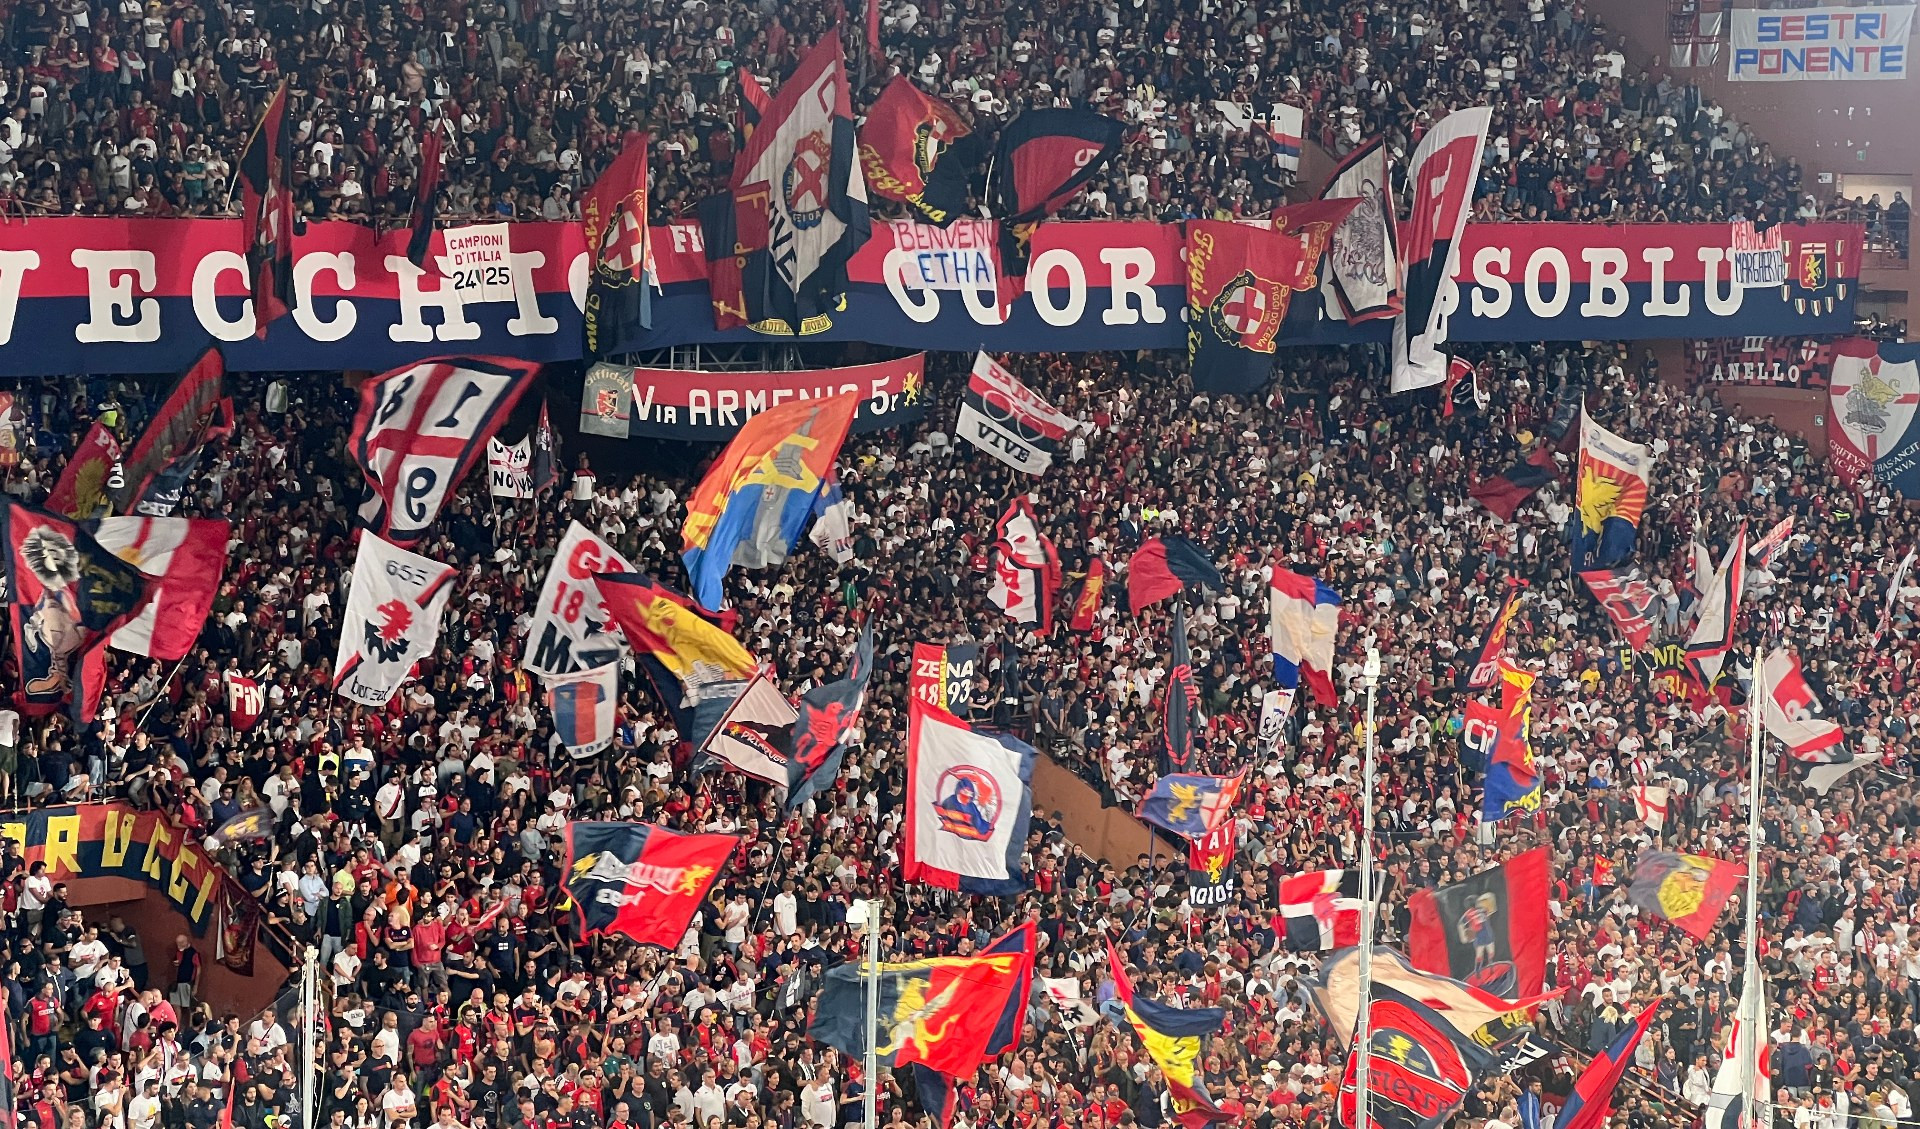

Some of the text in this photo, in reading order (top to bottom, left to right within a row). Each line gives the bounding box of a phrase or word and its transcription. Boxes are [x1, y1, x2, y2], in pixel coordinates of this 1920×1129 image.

[1758, 13, 1887, 42] SESTRI
[1735, 45, 1903, 74] PONENTE
[450, 234, 503, 250] CAMPIONI
[455, 250, 502, 266] D'ITALIA
[452, 266, 510, 291] 24 25
[1711, 362, 1800, 383] ANELLO
[977, 420, 1031, 464] VIVE
[916, 658, 974, 679] ZENA
